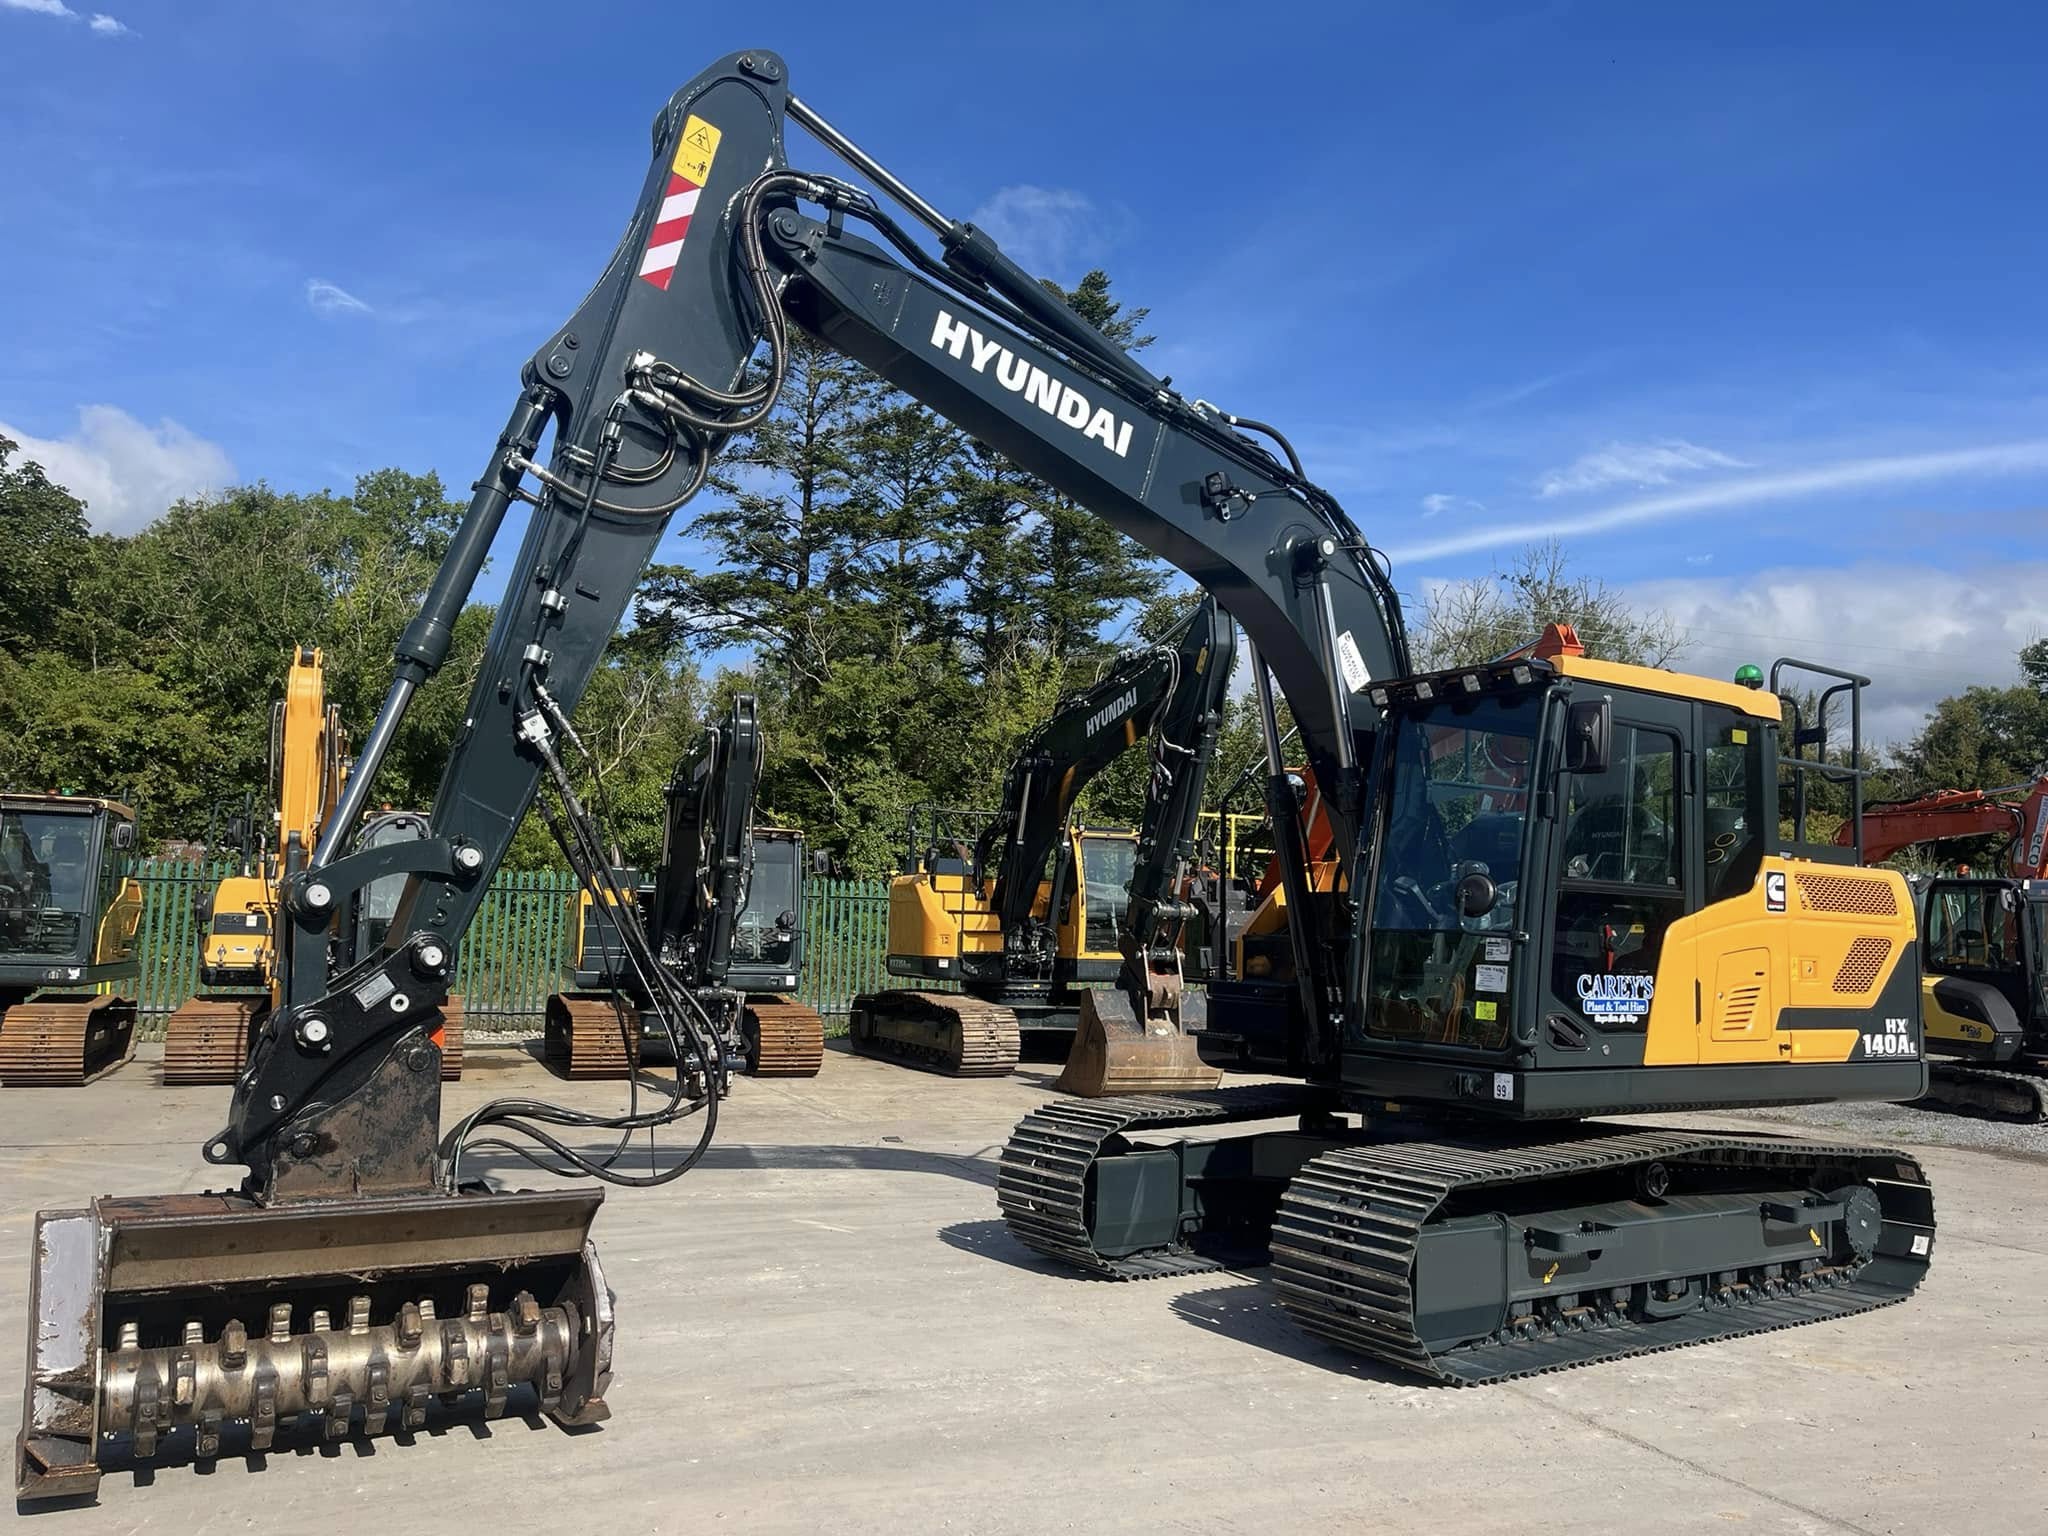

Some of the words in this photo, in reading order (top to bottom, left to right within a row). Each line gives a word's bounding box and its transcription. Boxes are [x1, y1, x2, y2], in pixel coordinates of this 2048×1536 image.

[930, 310, 1134, 458] HYUNDAI
[1086, 686, 1137, 738] HYUNDAI
[1586, 1001, 1605, 1012] Plant
[1606, 1001, 1614, 1012] &
[1614, 1001, 1629, 1012] Tool
[1630, 1001, 1646, 1012] Hire
[1885, 1018, 1908, 1034] HX
[1496, 1084, 1507, 1097] 99
